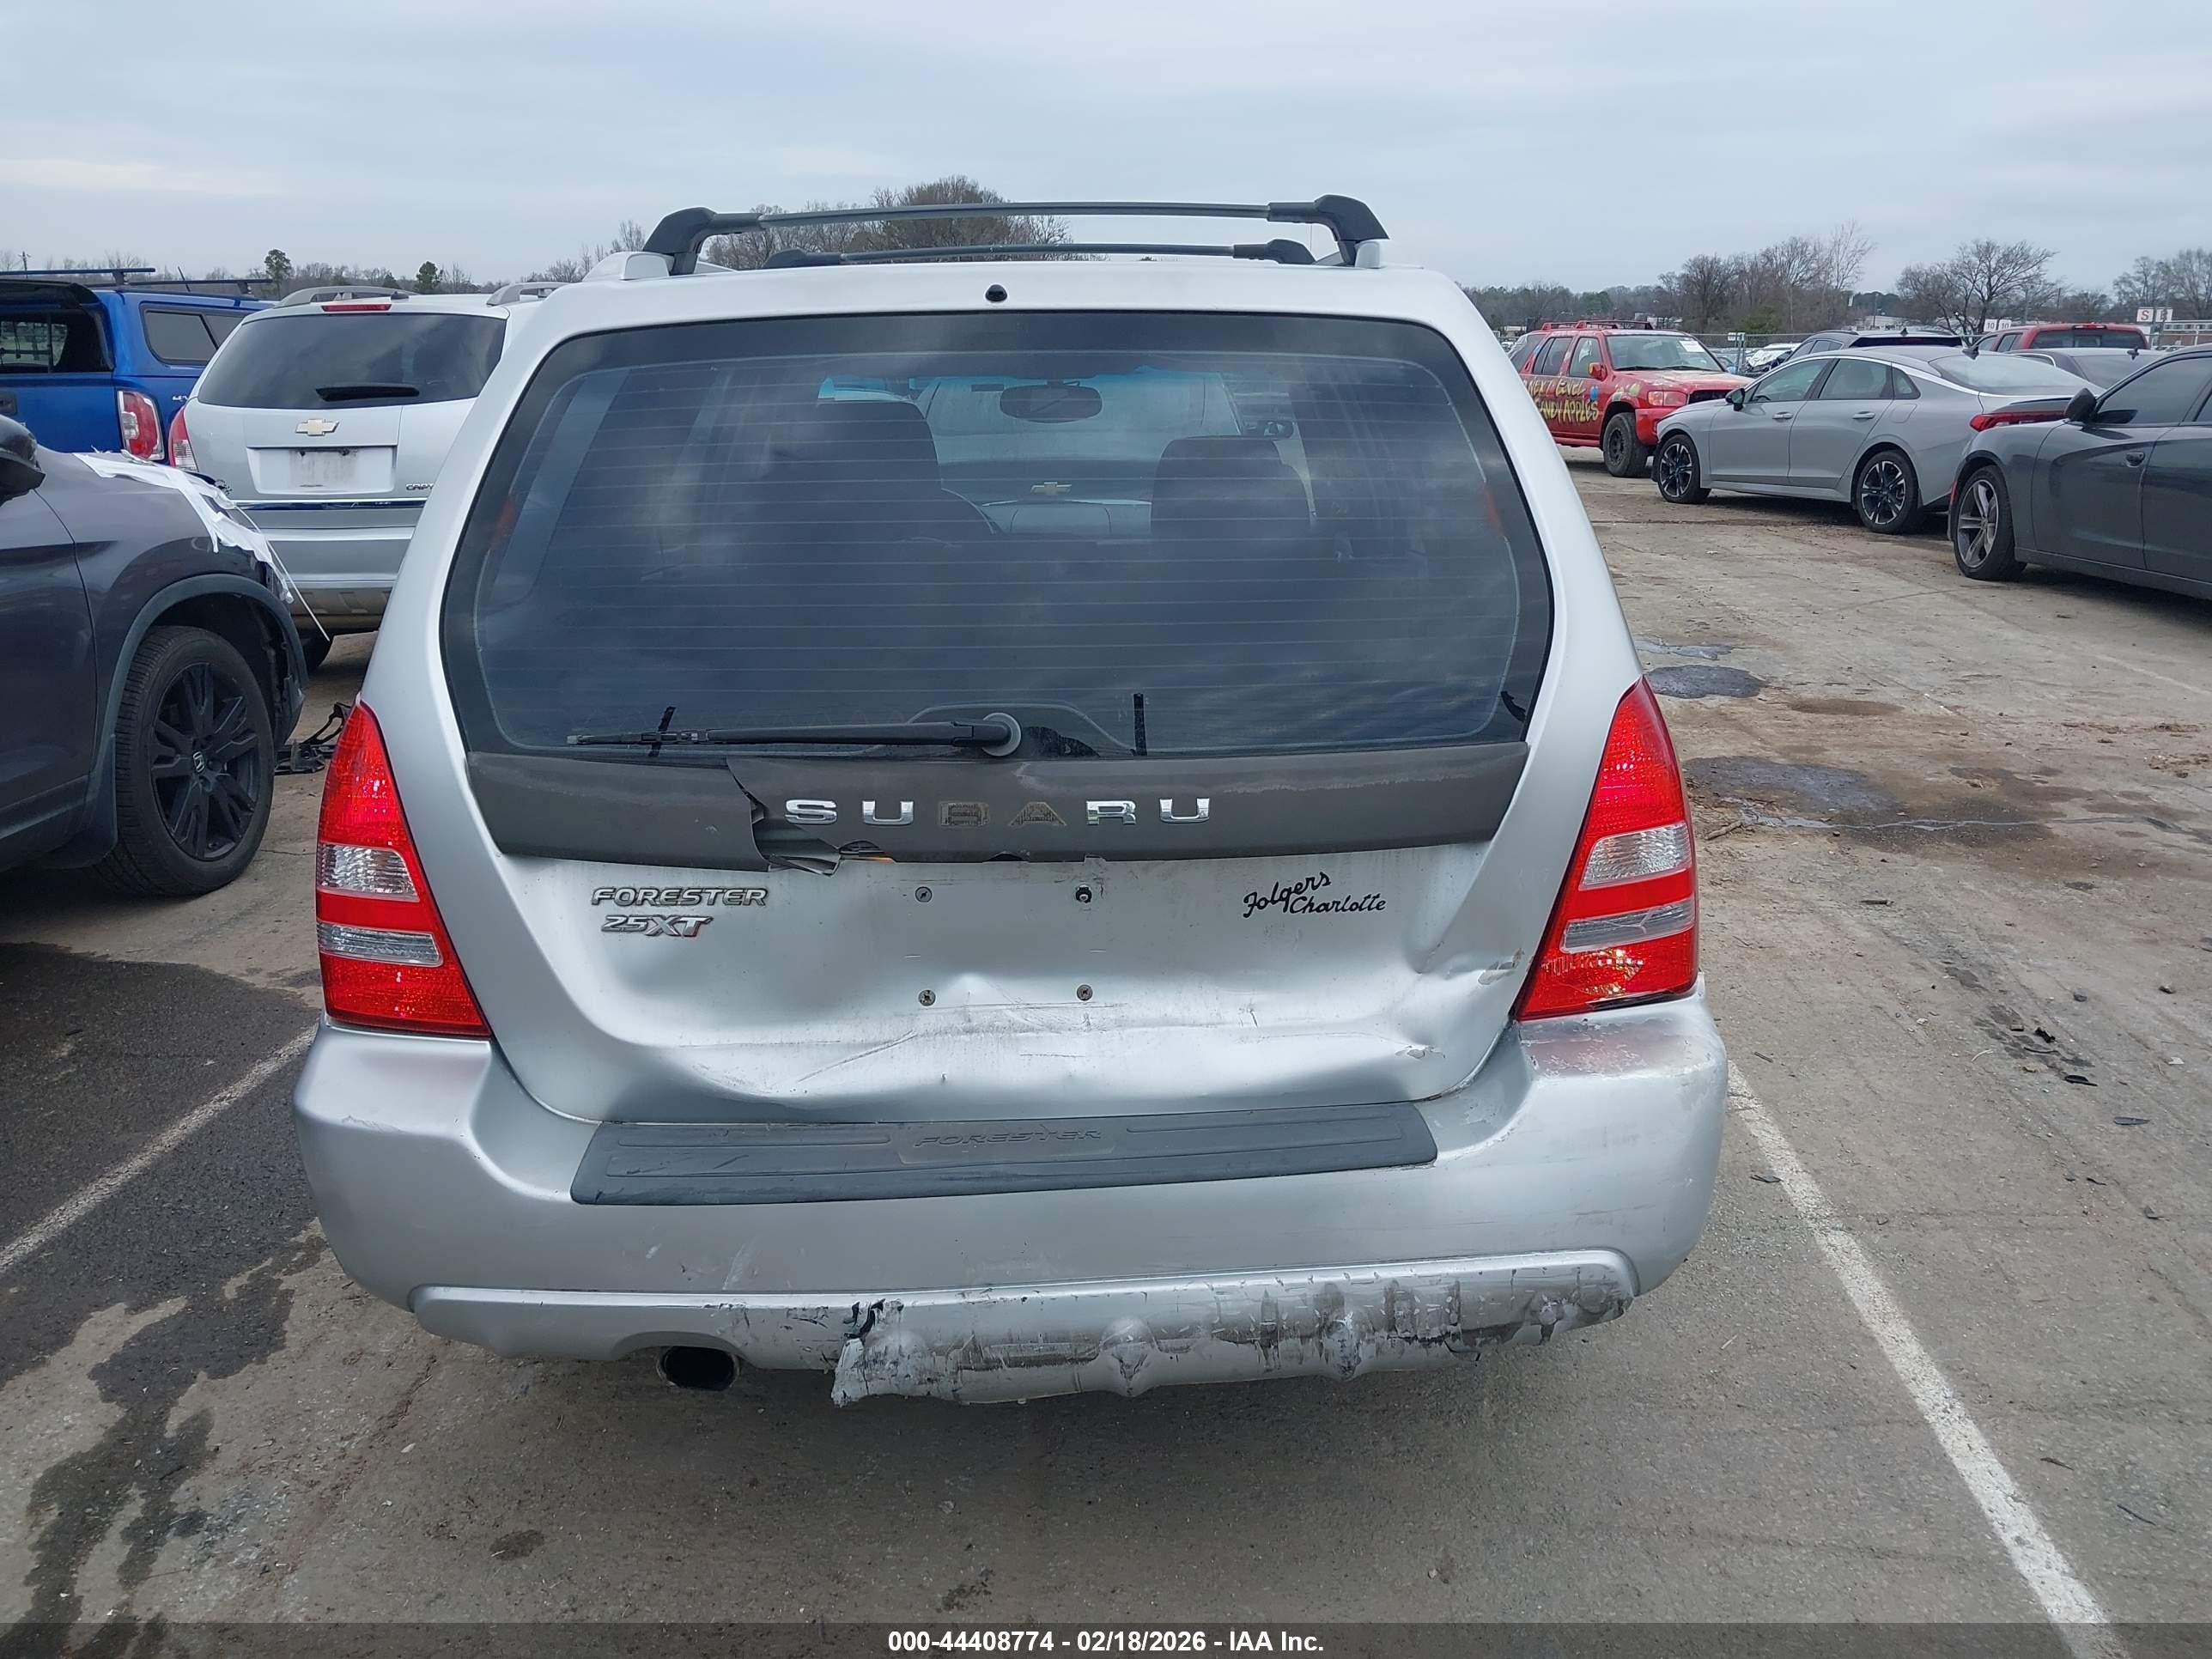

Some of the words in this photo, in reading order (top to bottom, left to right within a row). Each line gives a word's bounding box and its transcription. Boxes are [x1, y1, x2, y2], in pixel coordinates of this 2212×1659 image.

[2141, 310, 2149, 320] S
[785, 798, 1210, 826] SUBARU
[591, 887, 768, 907] FORESTER
[1289, 893, 1386, 914] Charlotte
[914, 1130, 1103, 1147] FORESTER
